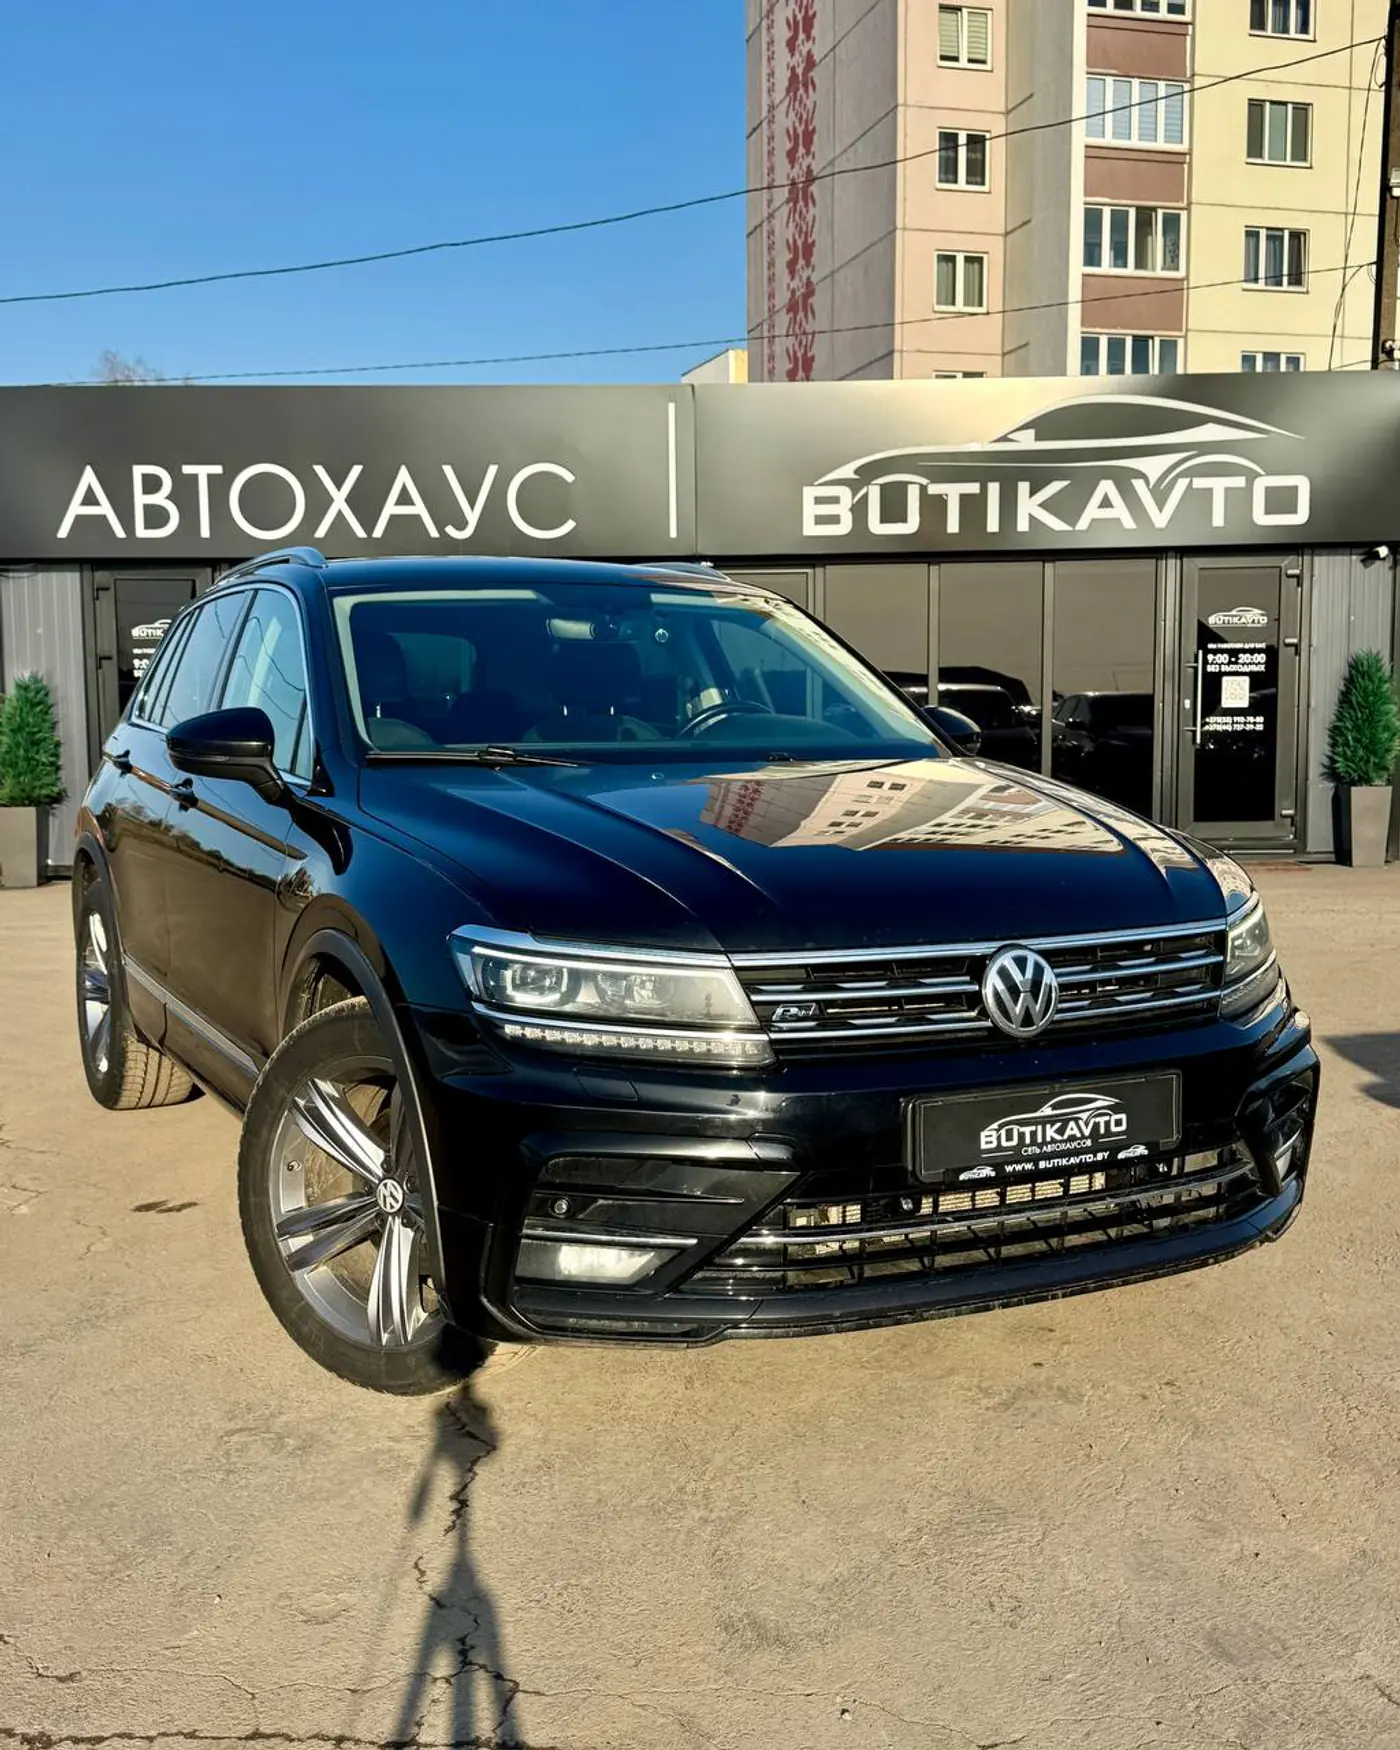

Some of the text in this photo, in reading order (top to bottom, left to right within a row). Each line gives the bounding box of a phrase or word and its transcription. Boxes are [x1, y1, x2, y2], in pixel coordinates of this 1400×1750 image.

[56, 462, 577, 541] АВТОХАУС
[802, 474, 1311, 537] BUTIKAVTO
[1207, 653, 1230, 664] 9:00
[1237, 653, 1267, 664] 20:00
[980, 1112, 1128, 1150] BUTIKAVTO
[1004, 1151, 1110, 1174] WWW. BUTIKAVTO.BY
[1021, 1139, 1093, 1156] СЕТЬ АВТОХАУСОВ
